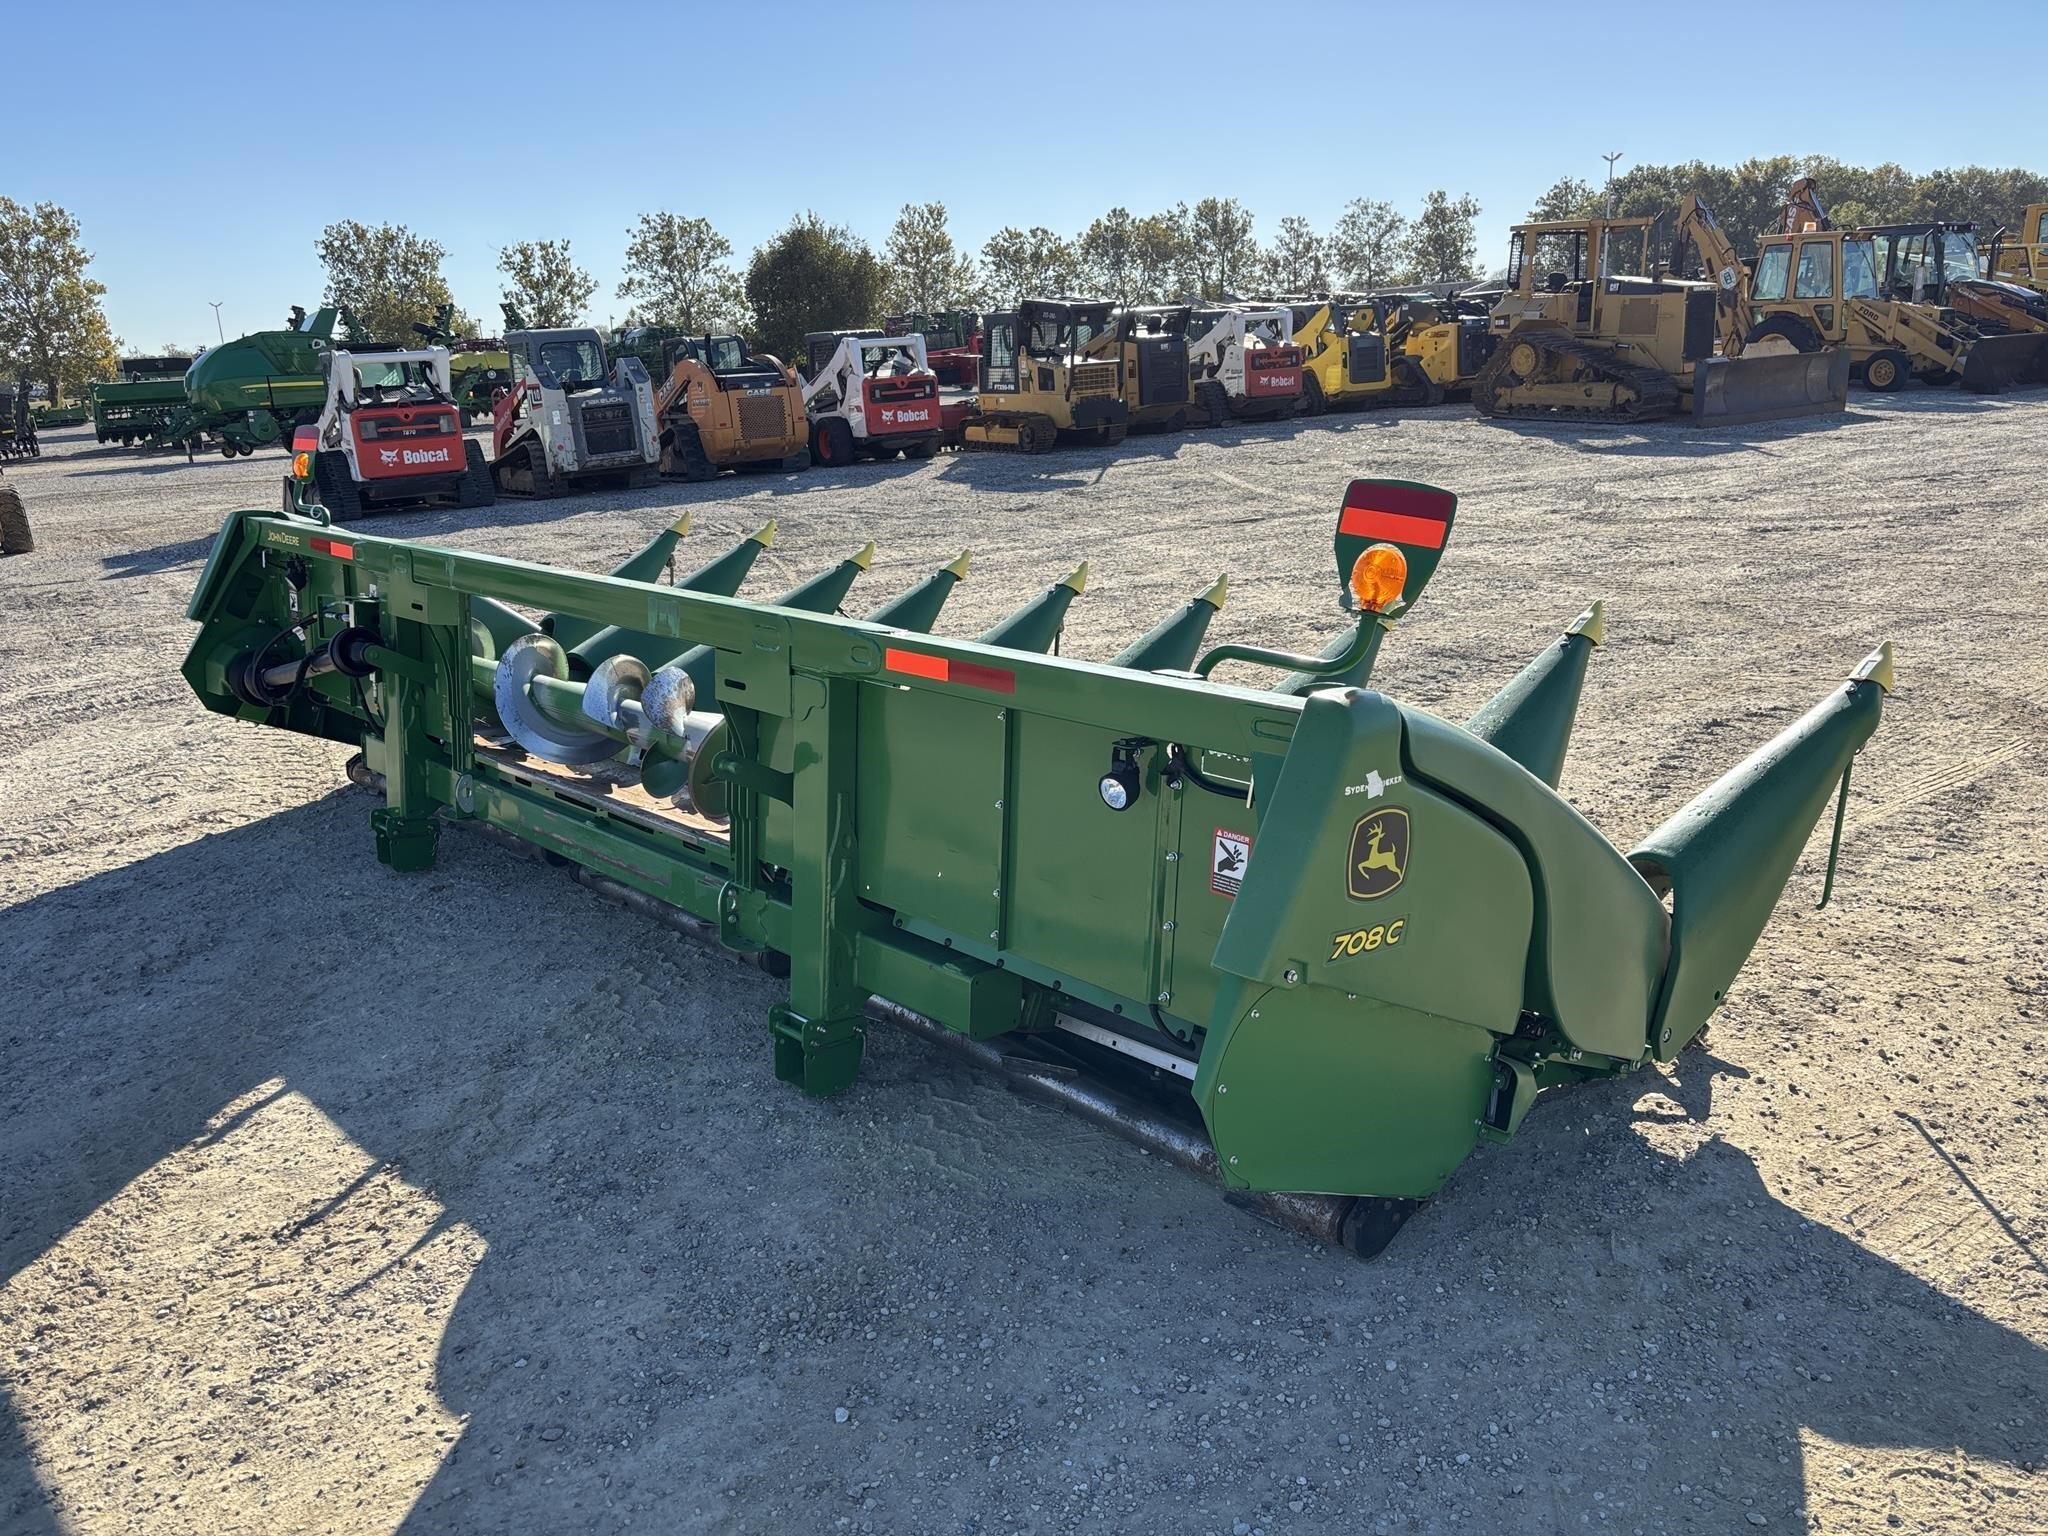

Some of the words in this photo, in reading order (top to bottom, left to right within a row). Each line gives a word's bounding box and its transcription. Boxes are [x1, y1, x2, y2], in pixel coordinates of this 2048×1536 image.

[1859, 306, 1879, 321] FORD
[1271, 376, 1295, 387] Bobcat
[746, 388, 772, 396] CASE
[897, 409, 929, 422] Bobcat
[402, 447, 449, 465] Bobcat
[267, 531, 282, 543] JOHN
[281, 532, 300, 546] DEERE
[1223, 831, 1250, 844] DANGER
